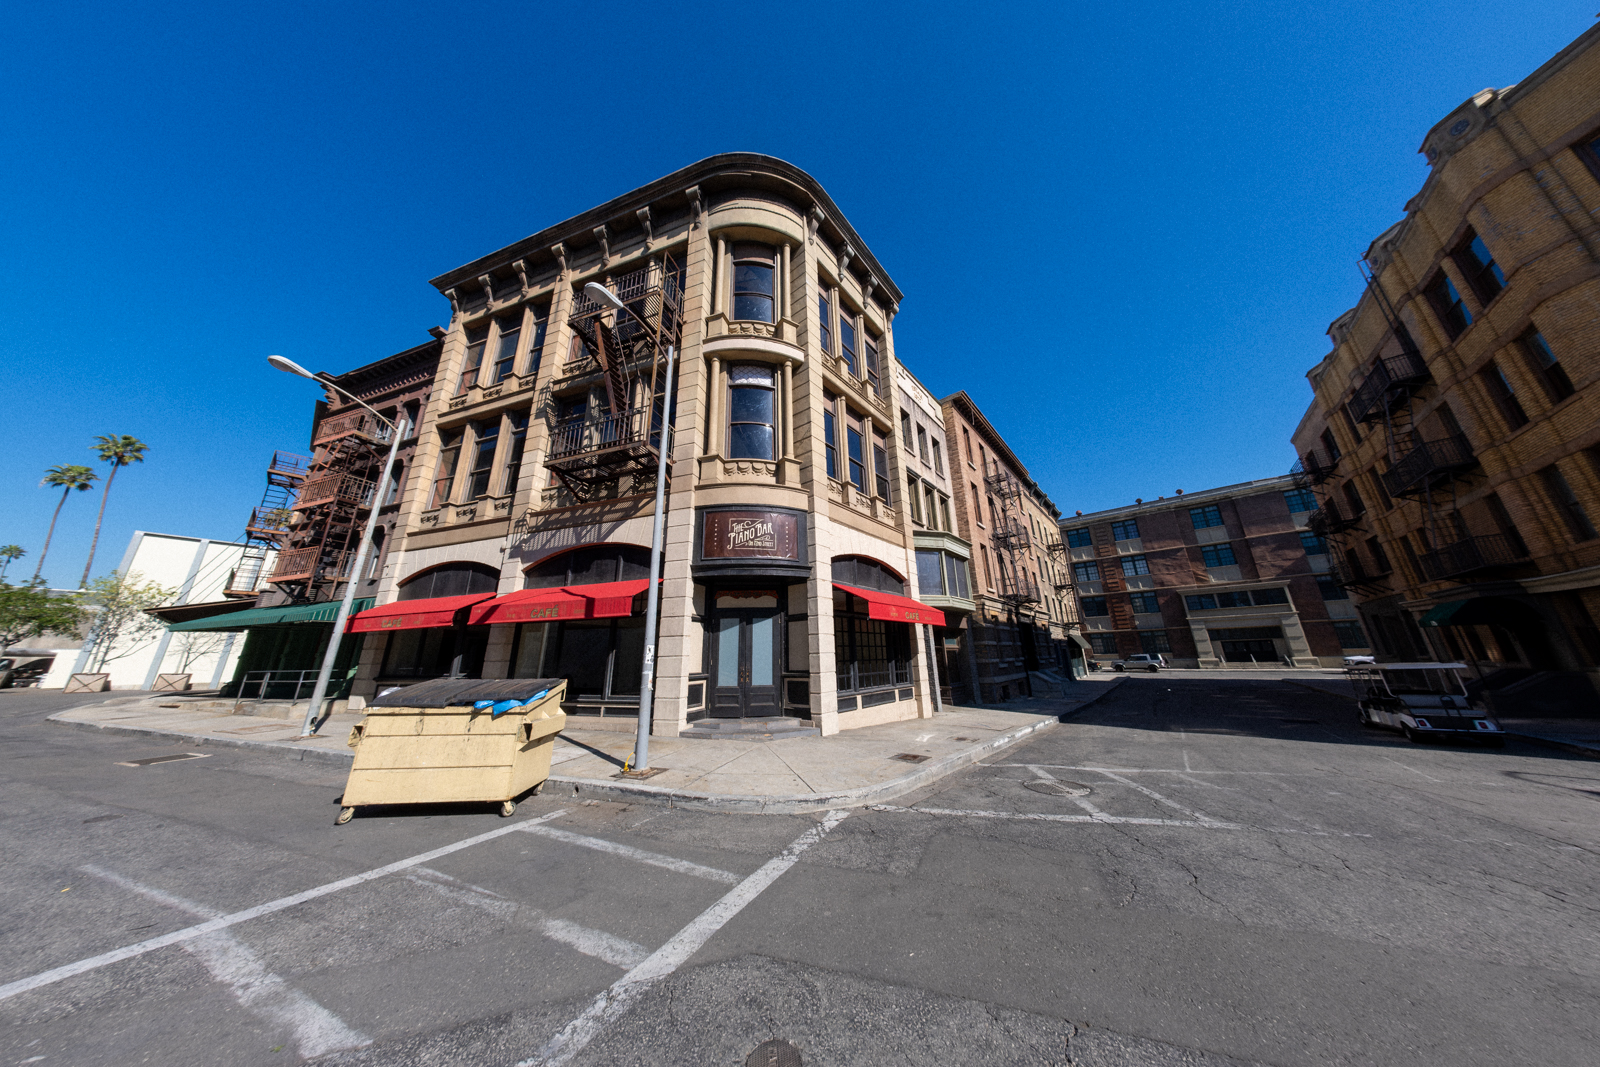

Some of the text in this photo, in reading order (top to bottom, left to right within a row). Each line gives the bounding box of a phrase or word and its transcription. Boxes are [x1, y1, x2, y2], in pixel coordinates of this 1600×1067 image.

[727, 522, 774, 550] PIANO BAR
[530, 604, 559, 619] CAFÉ
[905, 610, 920, 621] CAFÉ
[381, 616, 403, 628] CAFÉ
